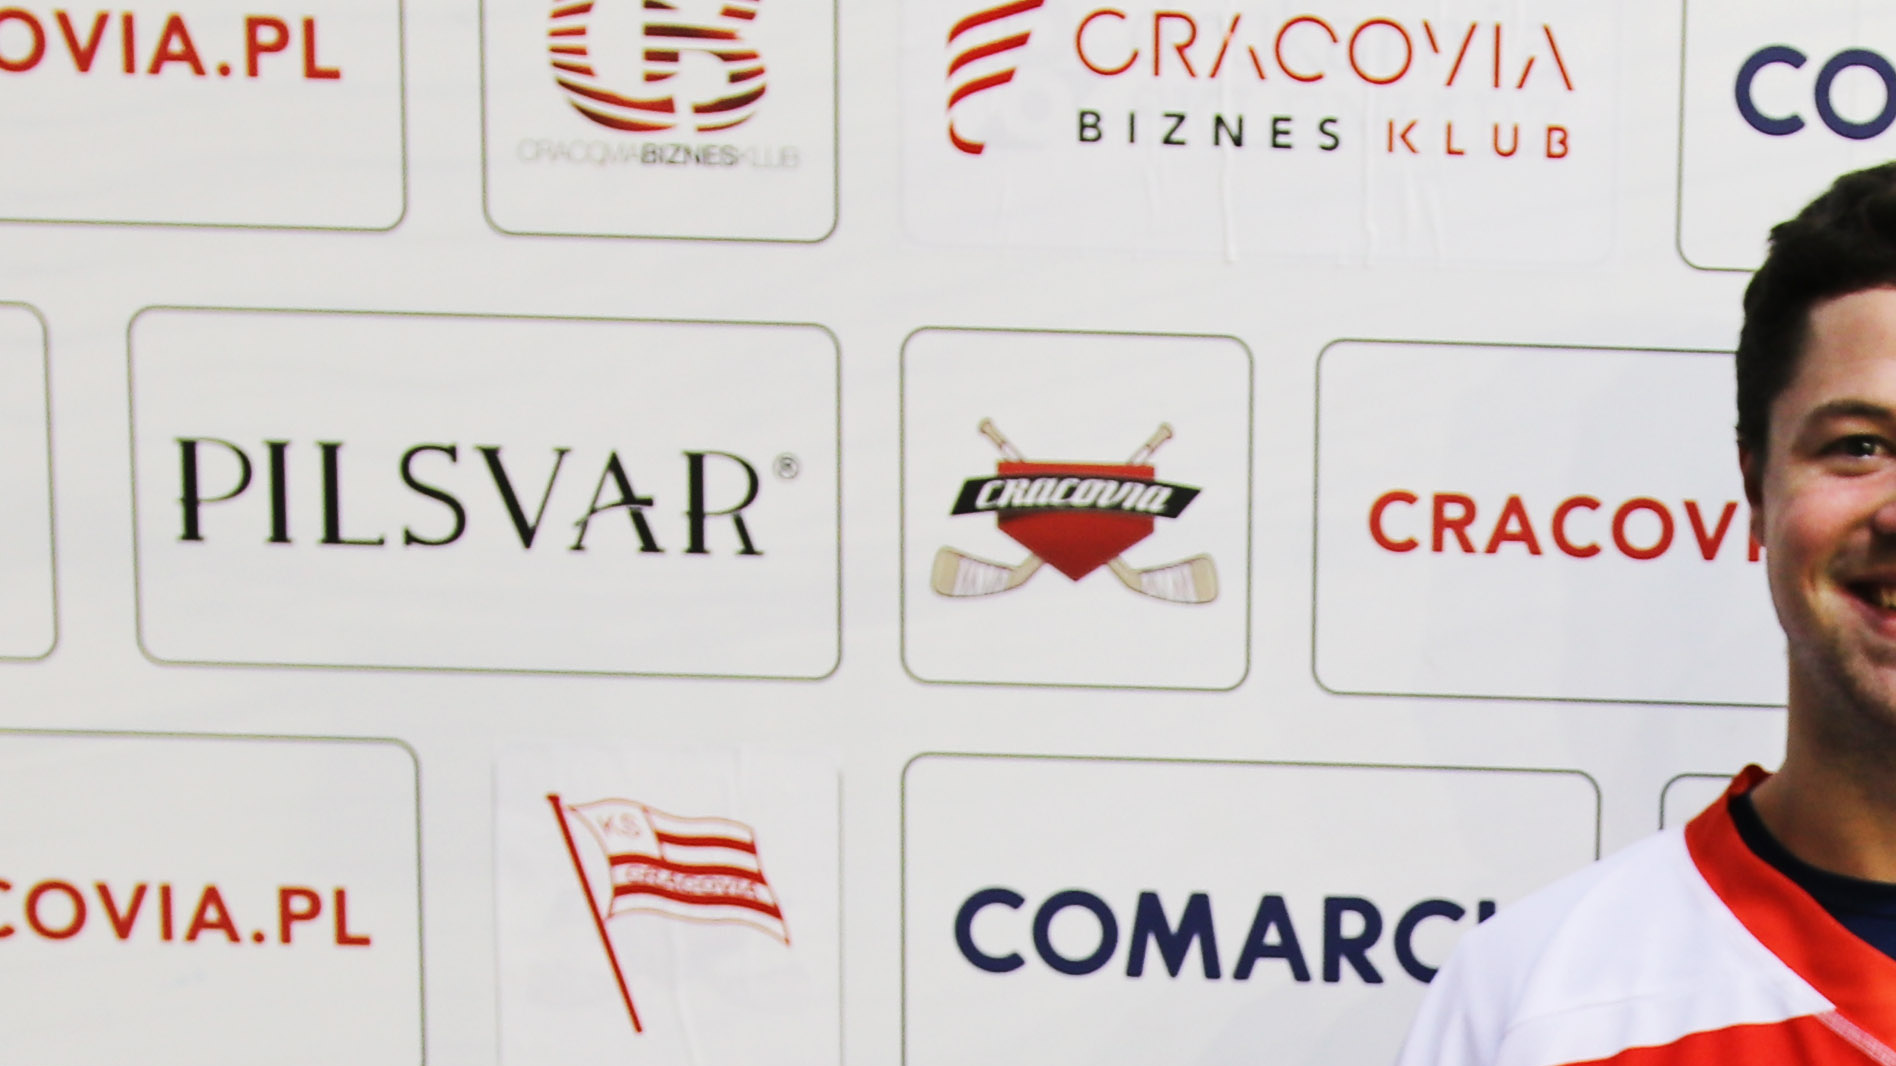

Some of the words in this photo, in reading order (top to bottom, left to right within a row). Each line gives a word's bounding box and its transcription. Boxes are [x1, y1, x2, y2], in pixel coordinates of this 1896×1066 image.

[1074, 8, 1574, 91] CRACOVIA
[1078, 109, 1340, 151] BIZNES
[1387, 119, 1570, 159] KLUB
[0, 877, 371, 946] OVIA.PL
[954, 886, 1497, 985] COMARC
